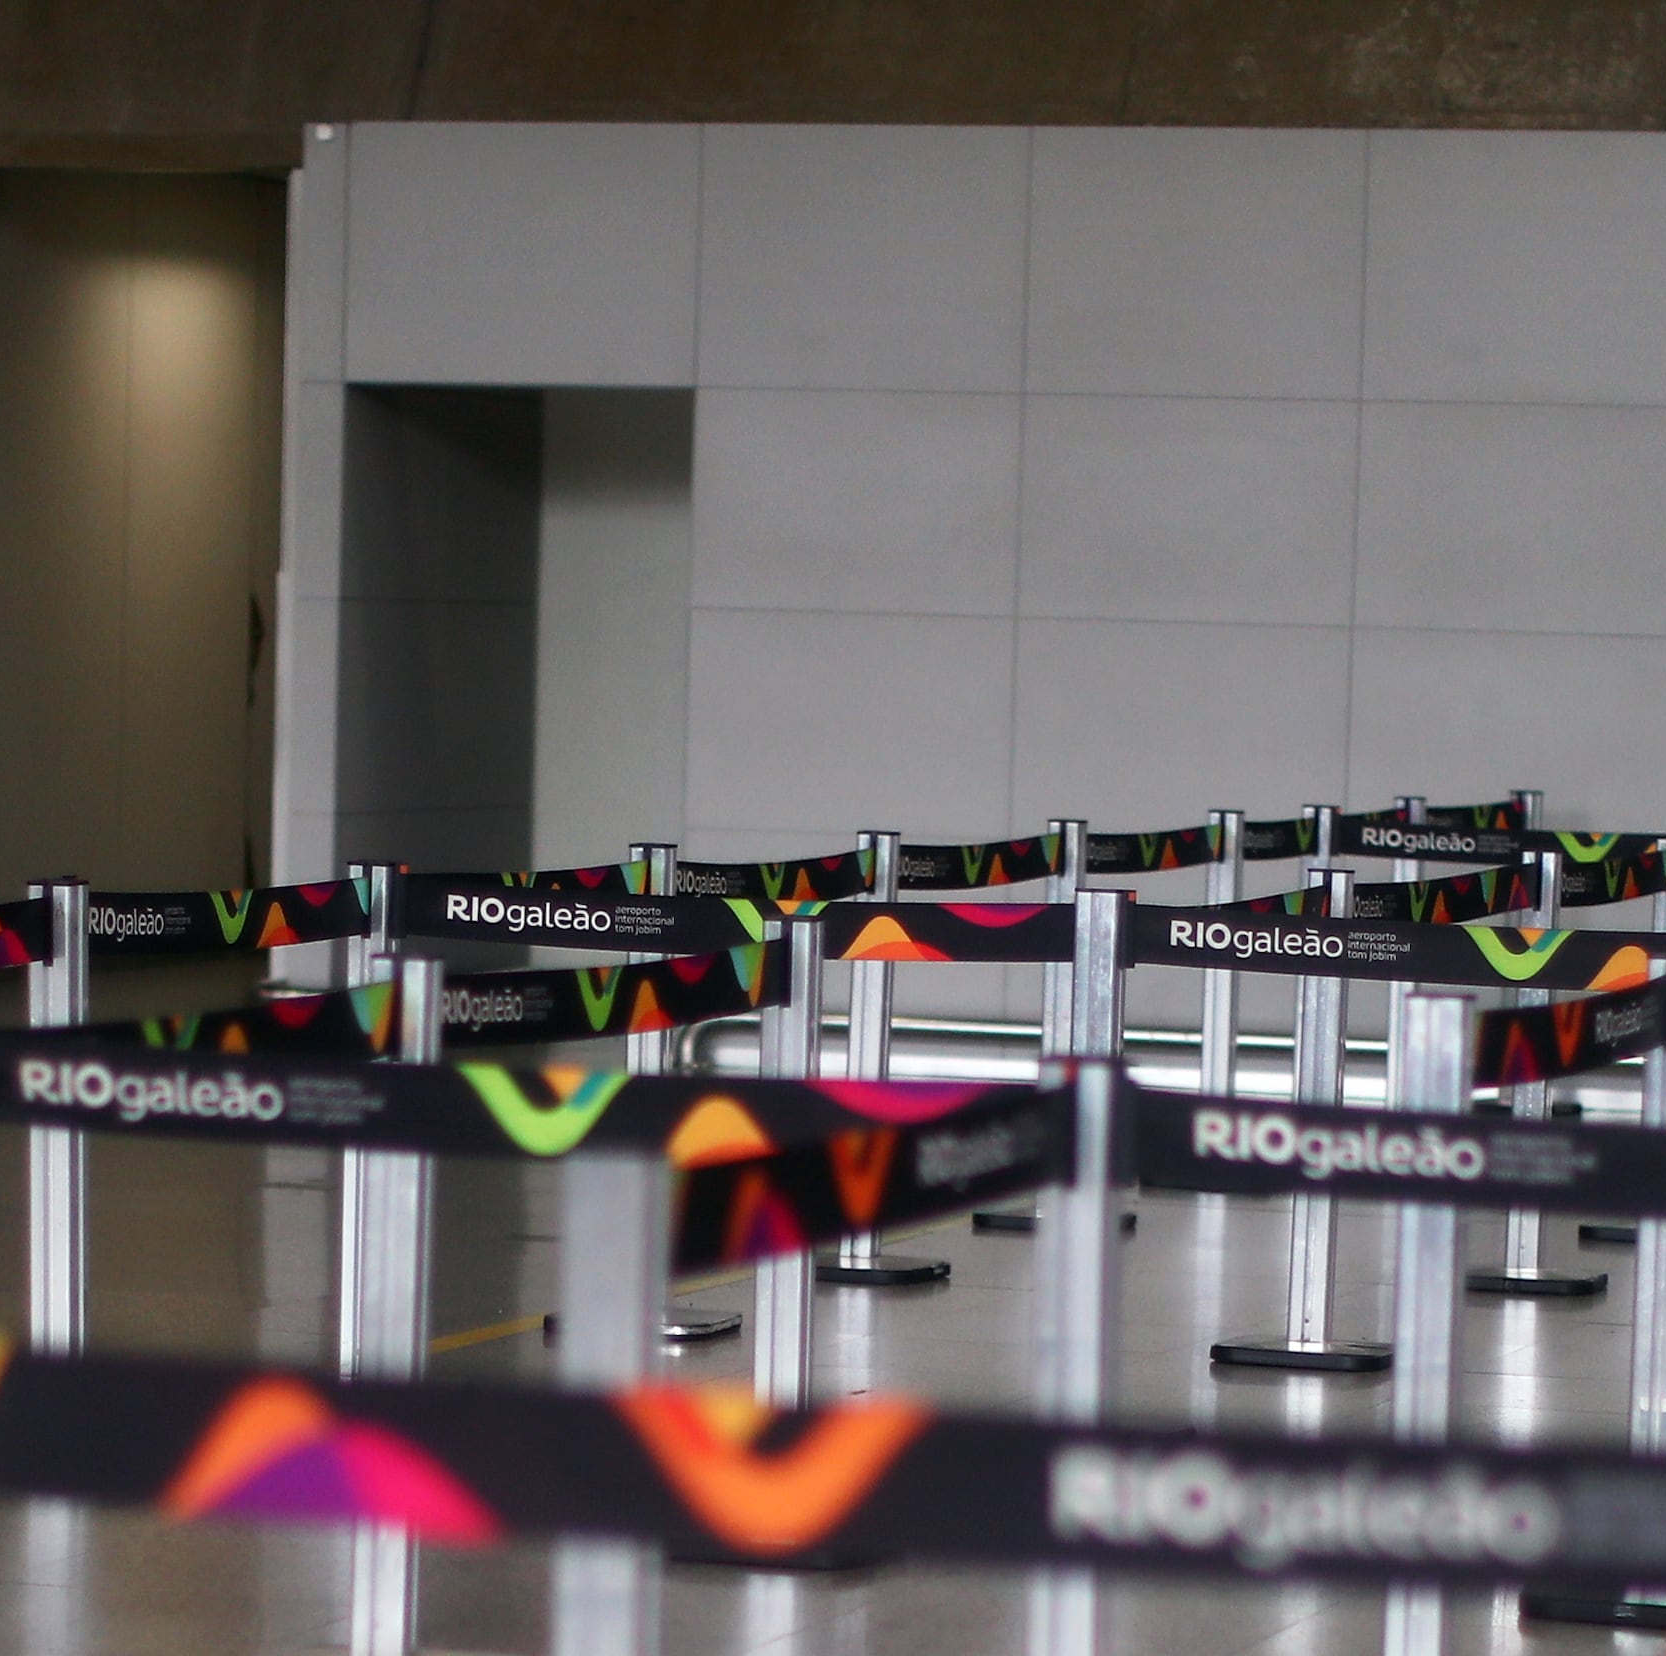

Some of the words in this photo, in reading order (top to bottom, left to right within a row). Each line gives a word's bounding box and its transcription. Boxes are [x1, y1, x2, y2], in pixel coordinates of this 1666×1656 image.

[1361, 827, 1476, 853] RIOgaleão
[446, 894, 611, 932] RIOgaleão
[614, 914, 675, 926] internacional
[615, 906, 662, 916] aeroporto
[88, 907, 165, 942] RIOgaleão
[615, 925, 634, 933] tom
[635, 925, 662, 936] jobim
[1170, 919, 1343, 958] RIOgaleão
[1347, 940, 1411, 952] internacional
[1348, 931, 1397, 942] aeroporto
[1347, 950, 1367, 959] tom
[1369, 951, 1397, 962] jobim
[19, 1059, 283, 1122] RIOgaleão
[1193, 1107, 1486, 1180] RIOgaleão
